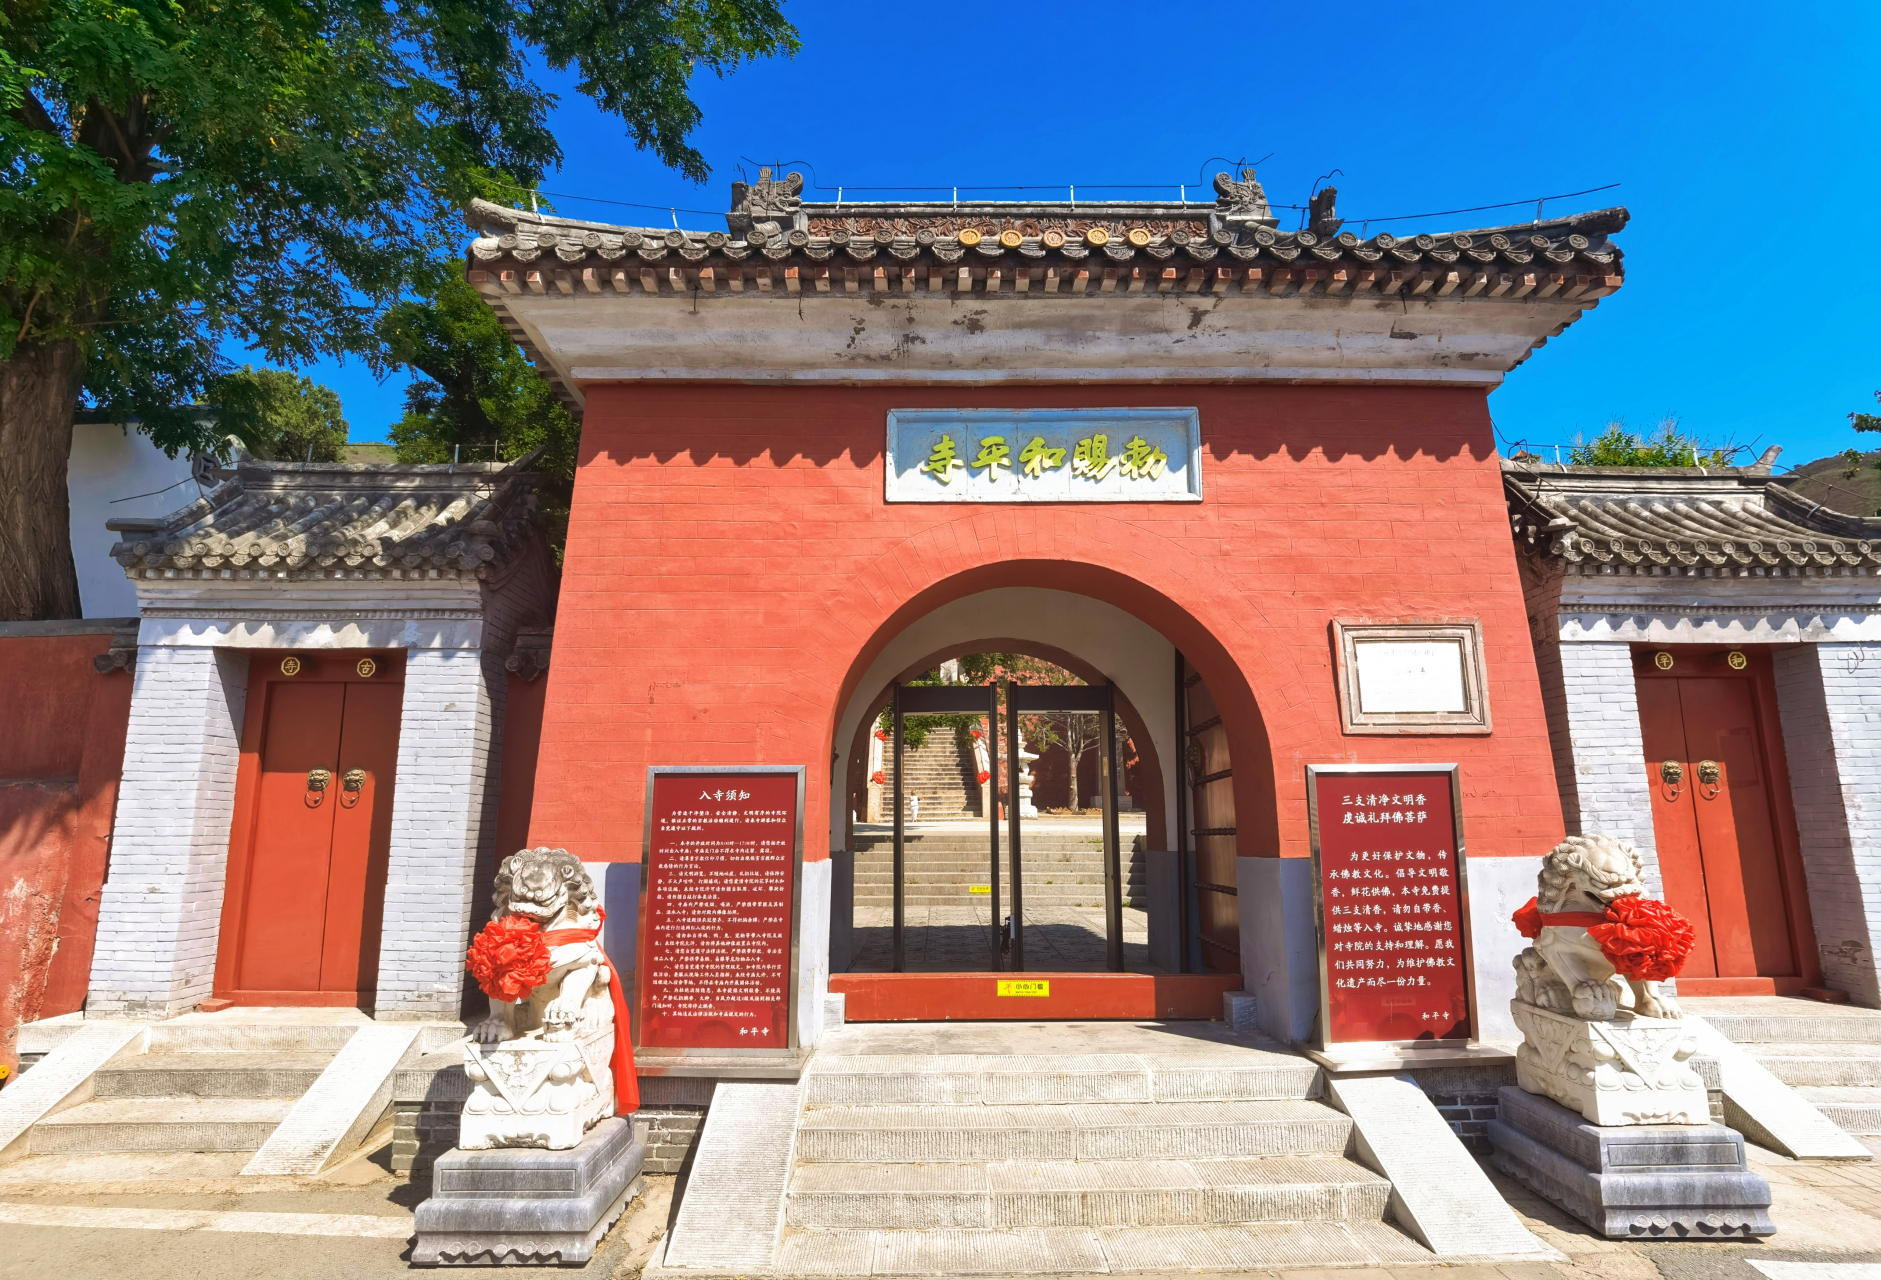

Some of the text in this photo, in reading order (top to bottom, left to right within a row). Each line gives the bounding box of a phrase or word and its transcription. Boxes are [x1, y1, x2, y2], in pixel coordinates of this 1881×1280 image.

[698, 788, 751, 802] 入寺须知
[1341, 794, 1427, 807] 三支清净文明香
[1342, 811, 1428, 825] 虔诚礼拜佛菩萨
[1421, 1012, 1450, 1021] 和平寺
[739, 1026, 770, 1037] 和平寺
